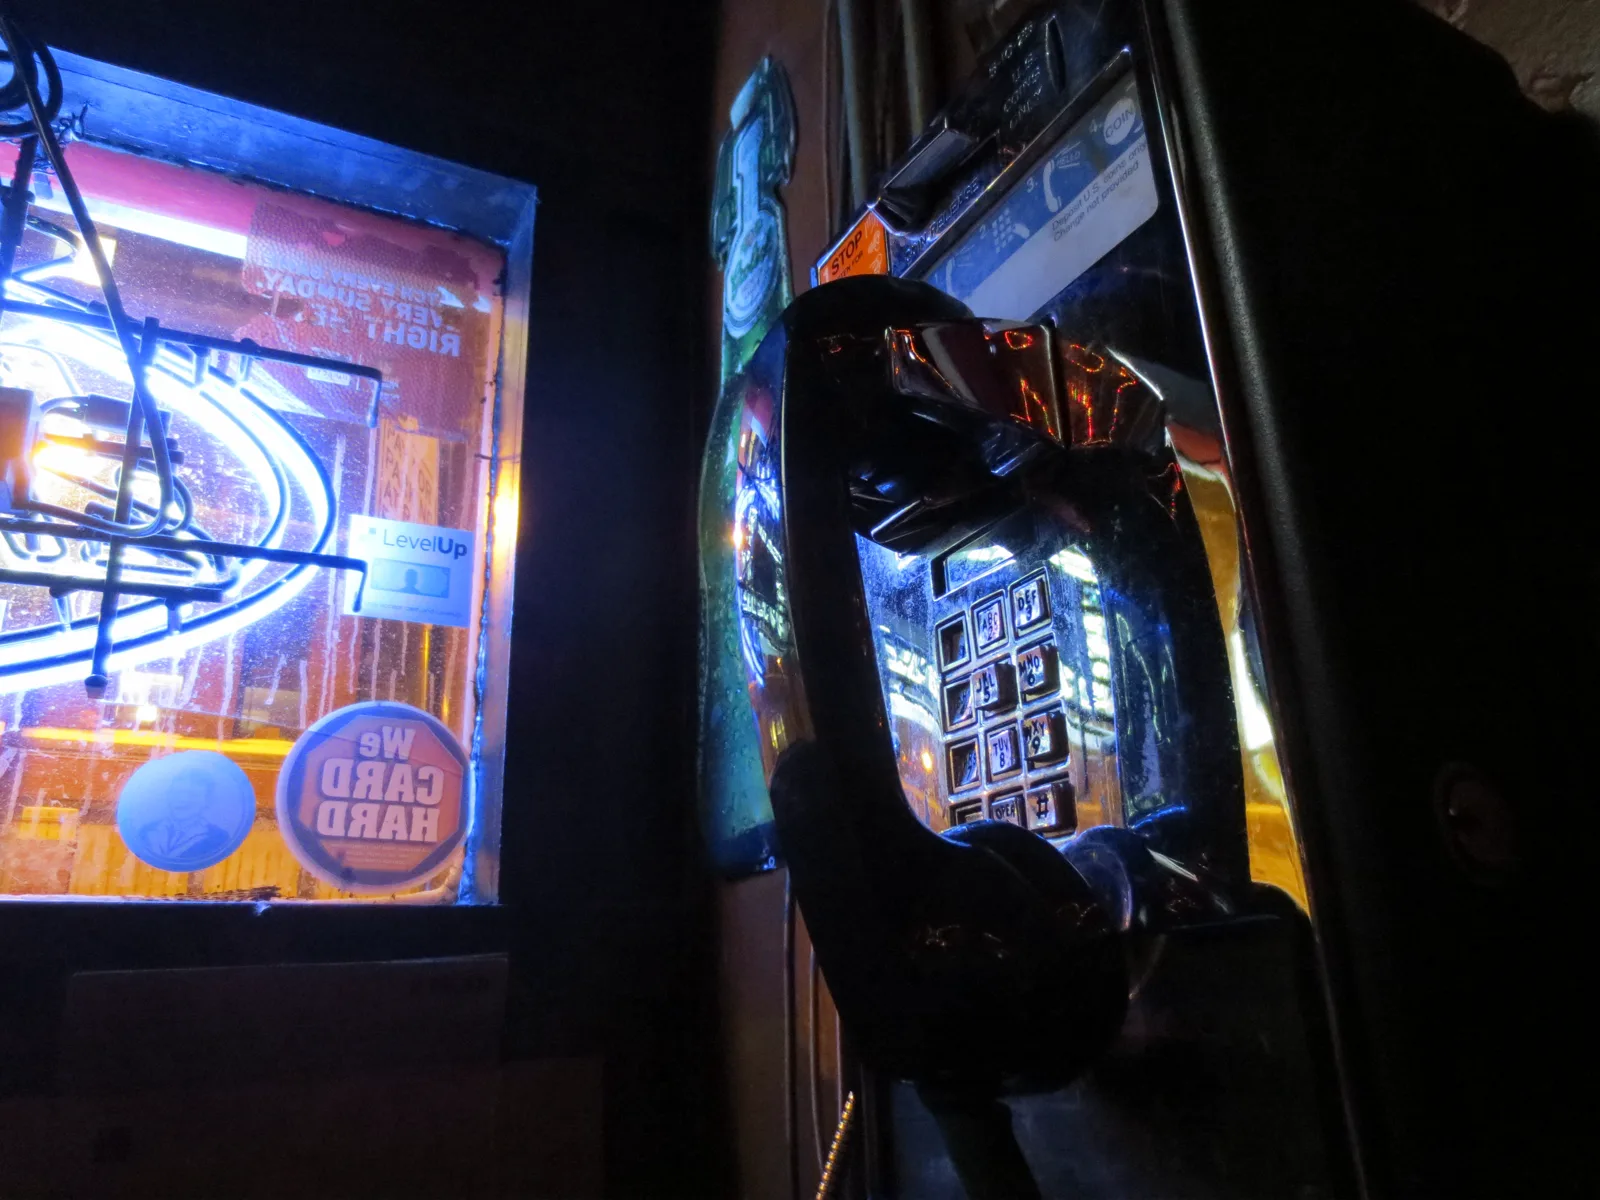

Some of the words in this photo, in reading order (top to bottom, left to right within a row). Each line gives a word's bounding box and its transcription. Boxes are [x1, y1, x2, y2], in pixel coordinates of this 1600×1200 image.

[1105, 108, 1134, 138] COIN
[1053, 212, 1085, 242] Change
[1086, 196, 1100, 214] not
[1101, 160, 1140, 202] provided
[1052, 199, 1083, 231] Deposit
[832, 230, 863, 276] STOP
[382, 528, 468, 560] LevelUp
[1017, 589, 1037, 611] DEF
[1026, 604, 1033, 622] 3
[1018, 654, 1040, 677] MNO
[1027, 669, 1036, 687] 6
[983, 685, 991, 703] 5
[992, 737, 1010, 757] TUV
[1031, 735, 1041, 756] 9
[1000, 752, 1006, 769] 8
